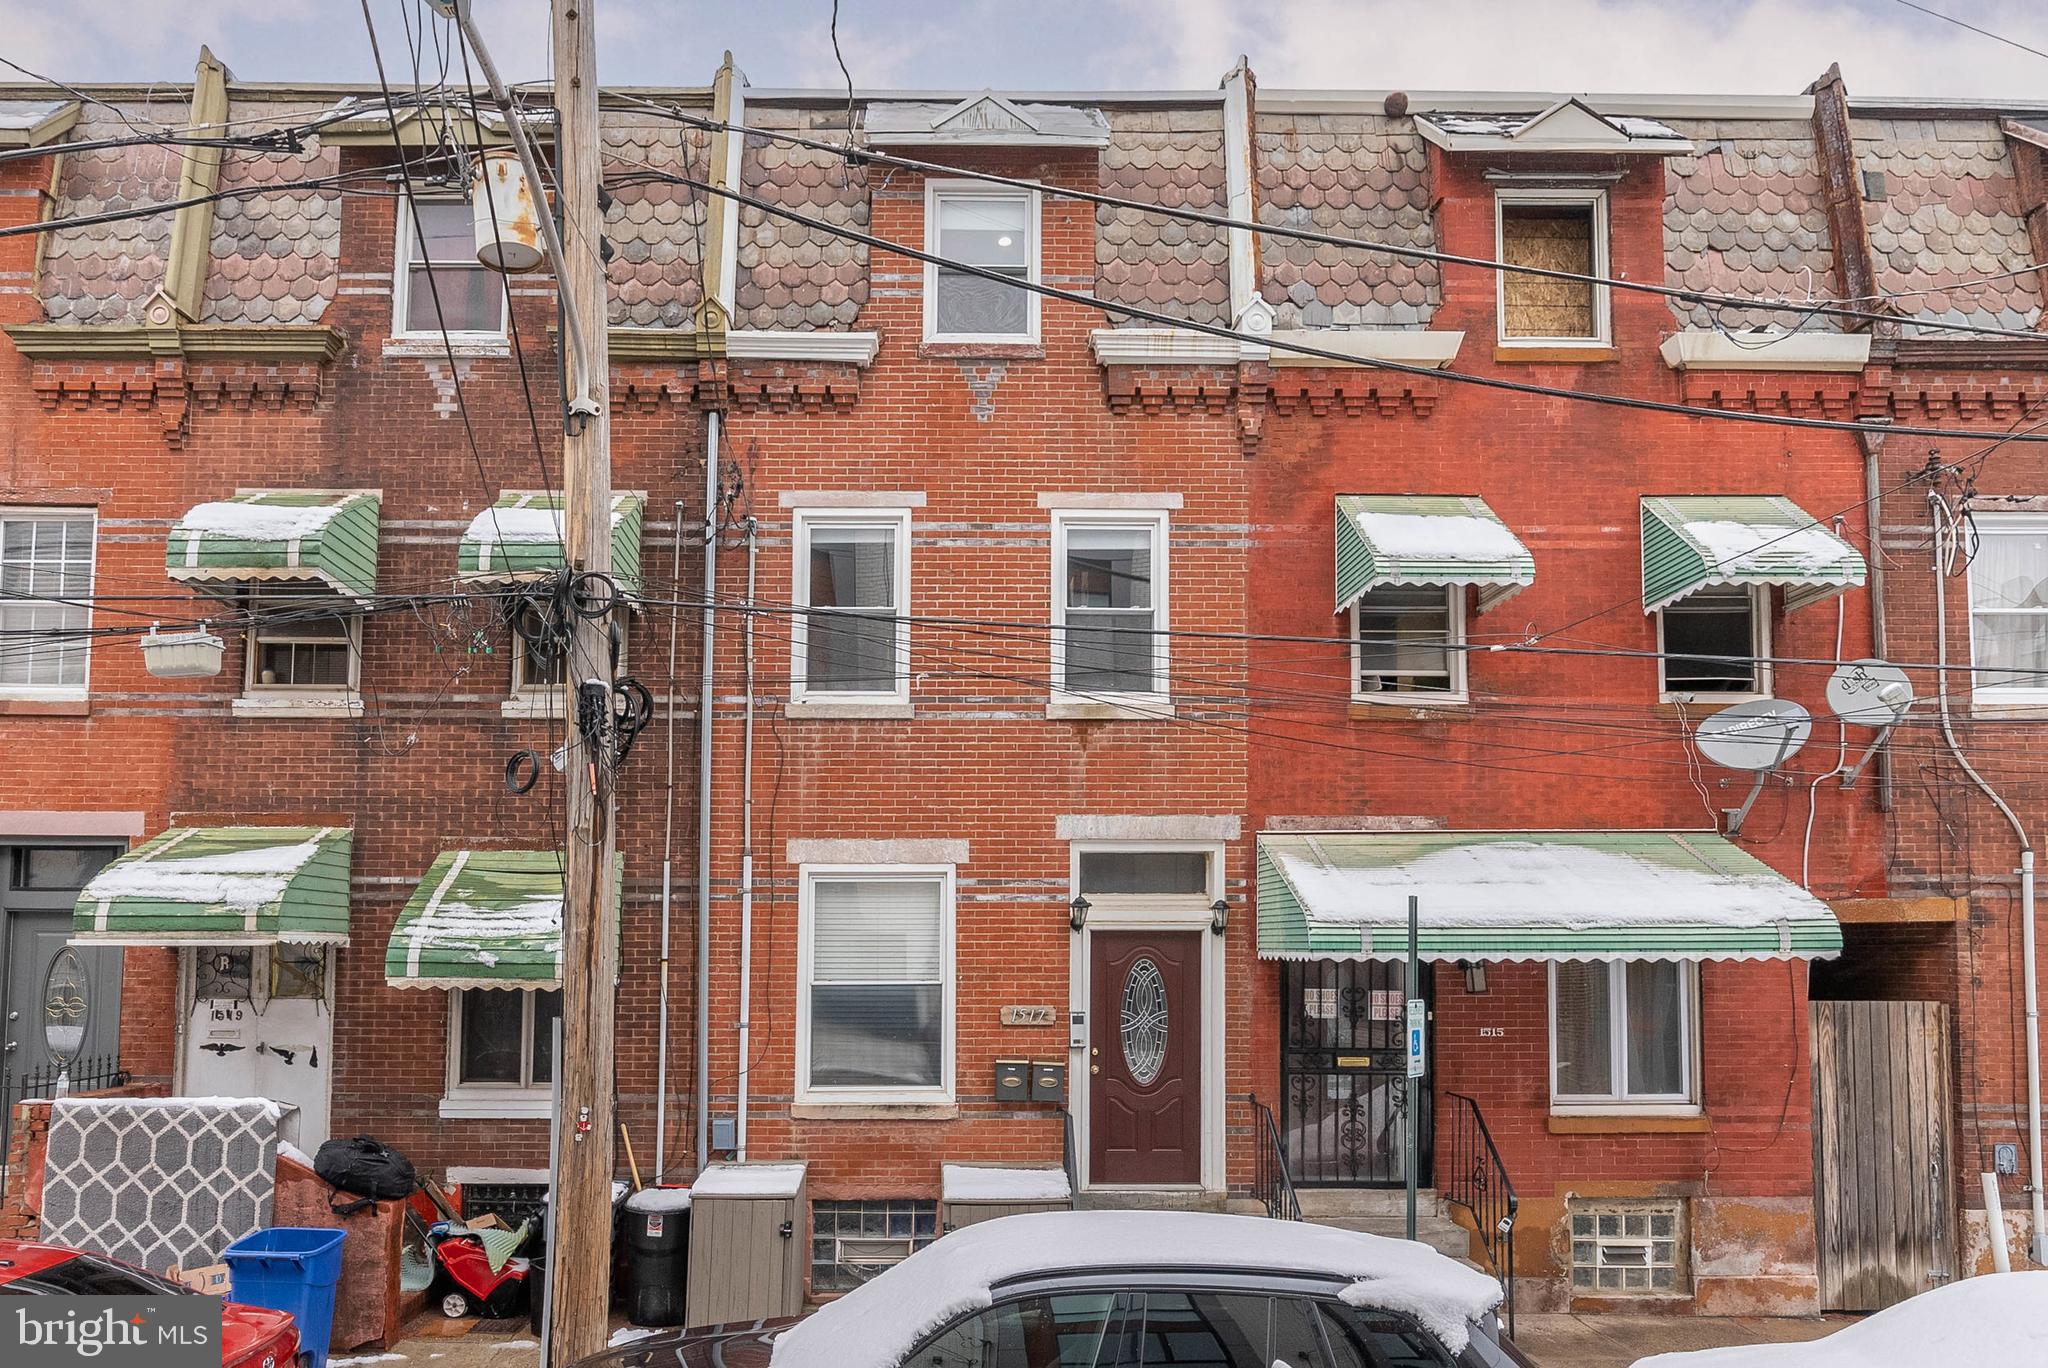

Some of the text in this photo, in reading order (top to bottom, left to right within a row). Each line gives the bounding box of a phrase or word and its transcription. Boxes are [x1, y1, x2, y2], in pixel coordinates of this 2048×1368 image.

[1380, 993, 1404, 1004] SOES
[1011, 1008, 1046, 1024] 1517
[1373, 1007, 1399, 1018] PLESE
[1480, 1027, 1504, 1037] 1515
